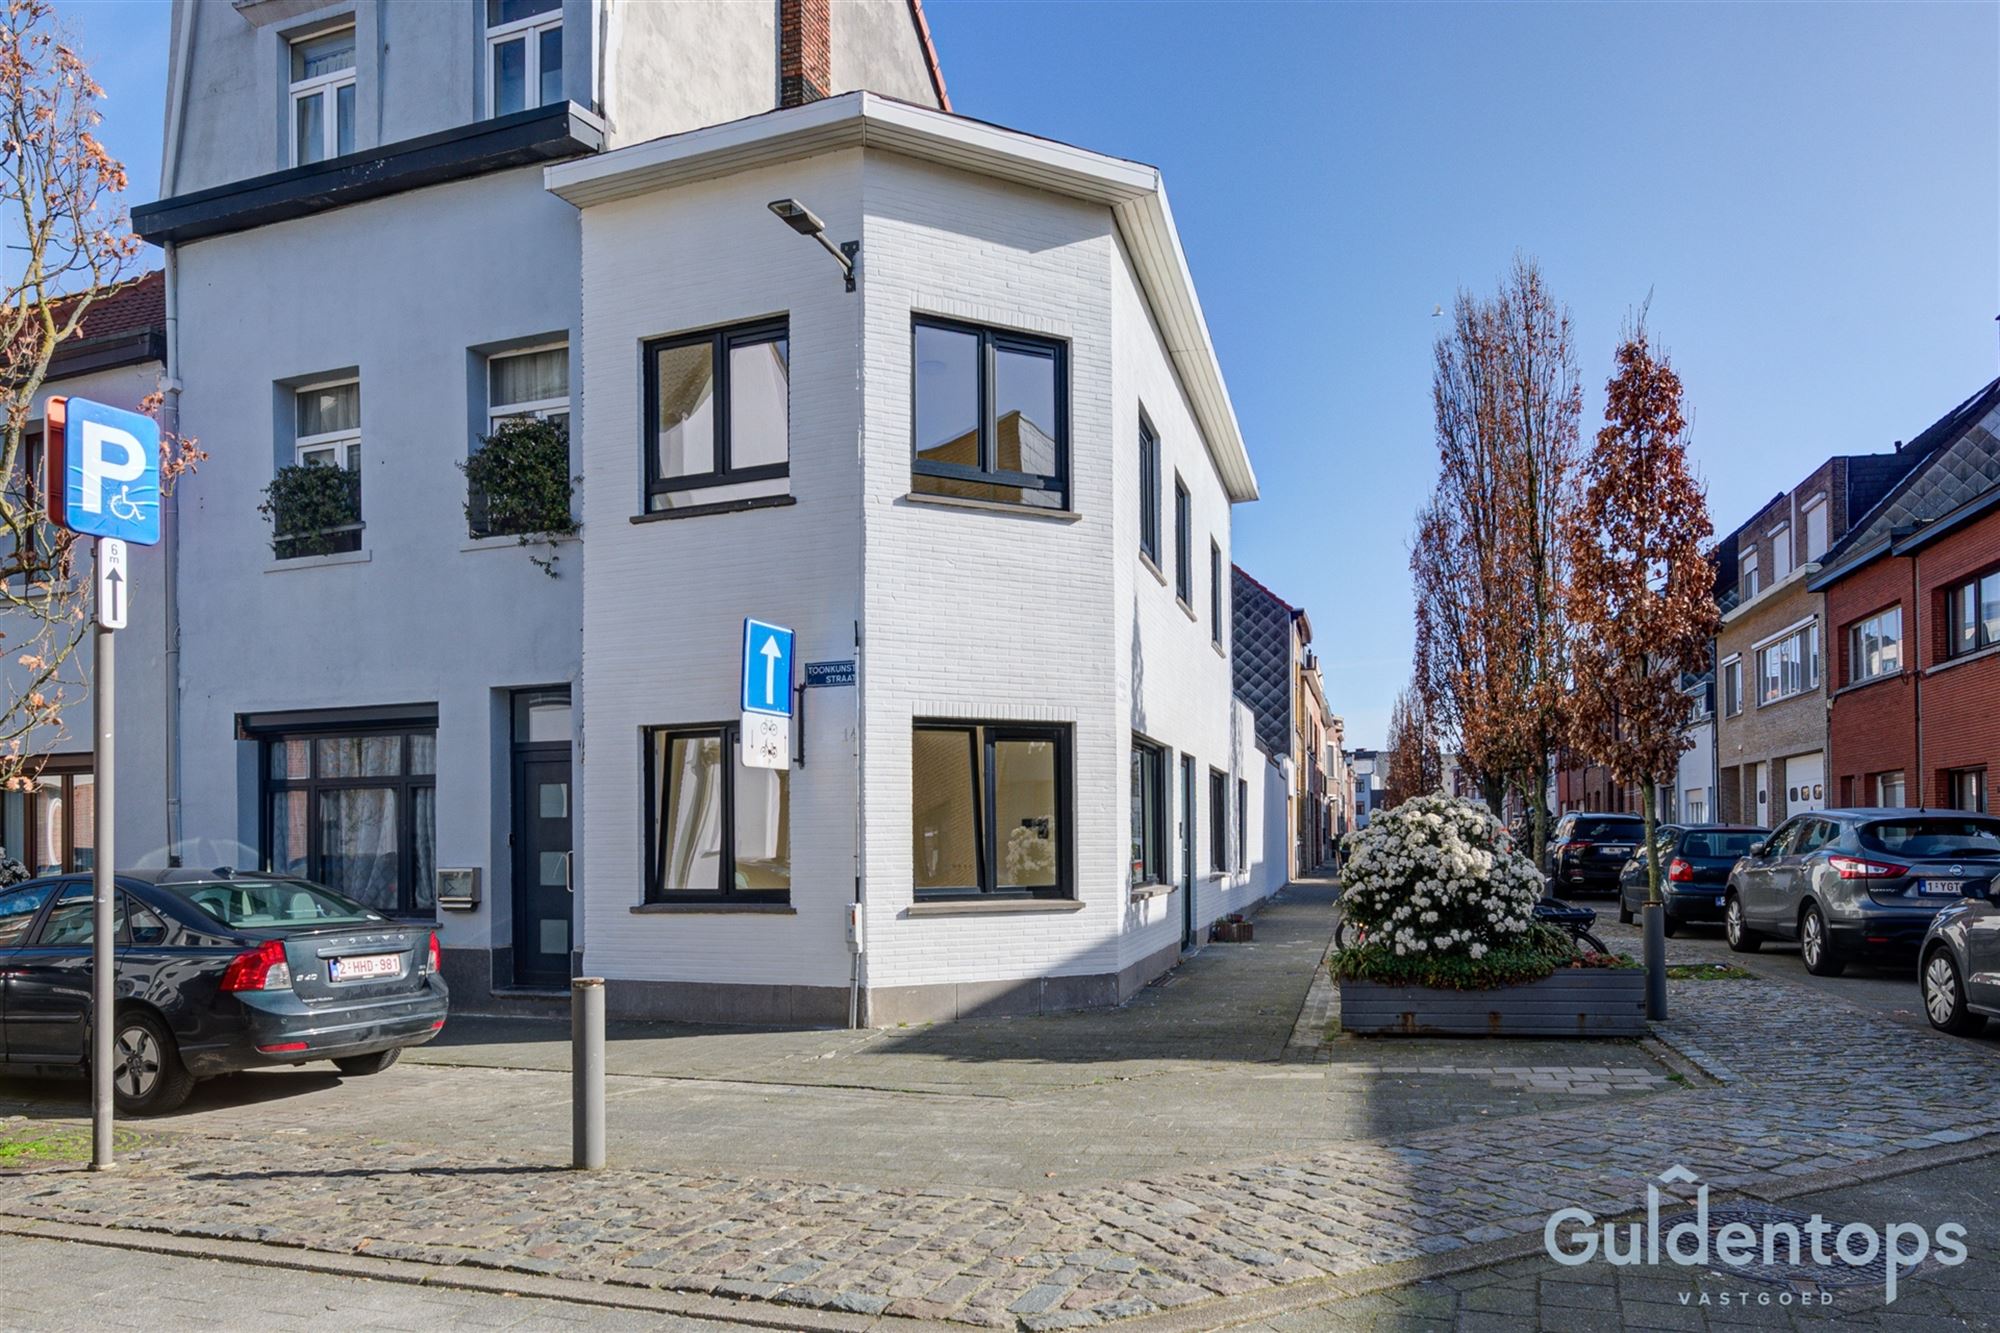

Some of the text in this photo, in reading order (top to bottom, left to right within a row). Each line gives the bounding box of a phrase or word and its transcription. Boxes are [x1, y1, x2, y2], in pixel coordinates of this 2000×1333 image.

[82, 420, 147, 514] P
[111, 543, 119, 556] 6
[109, 555, 120, 564] m
[1927, 882, 1961, 892] 1-YGT
